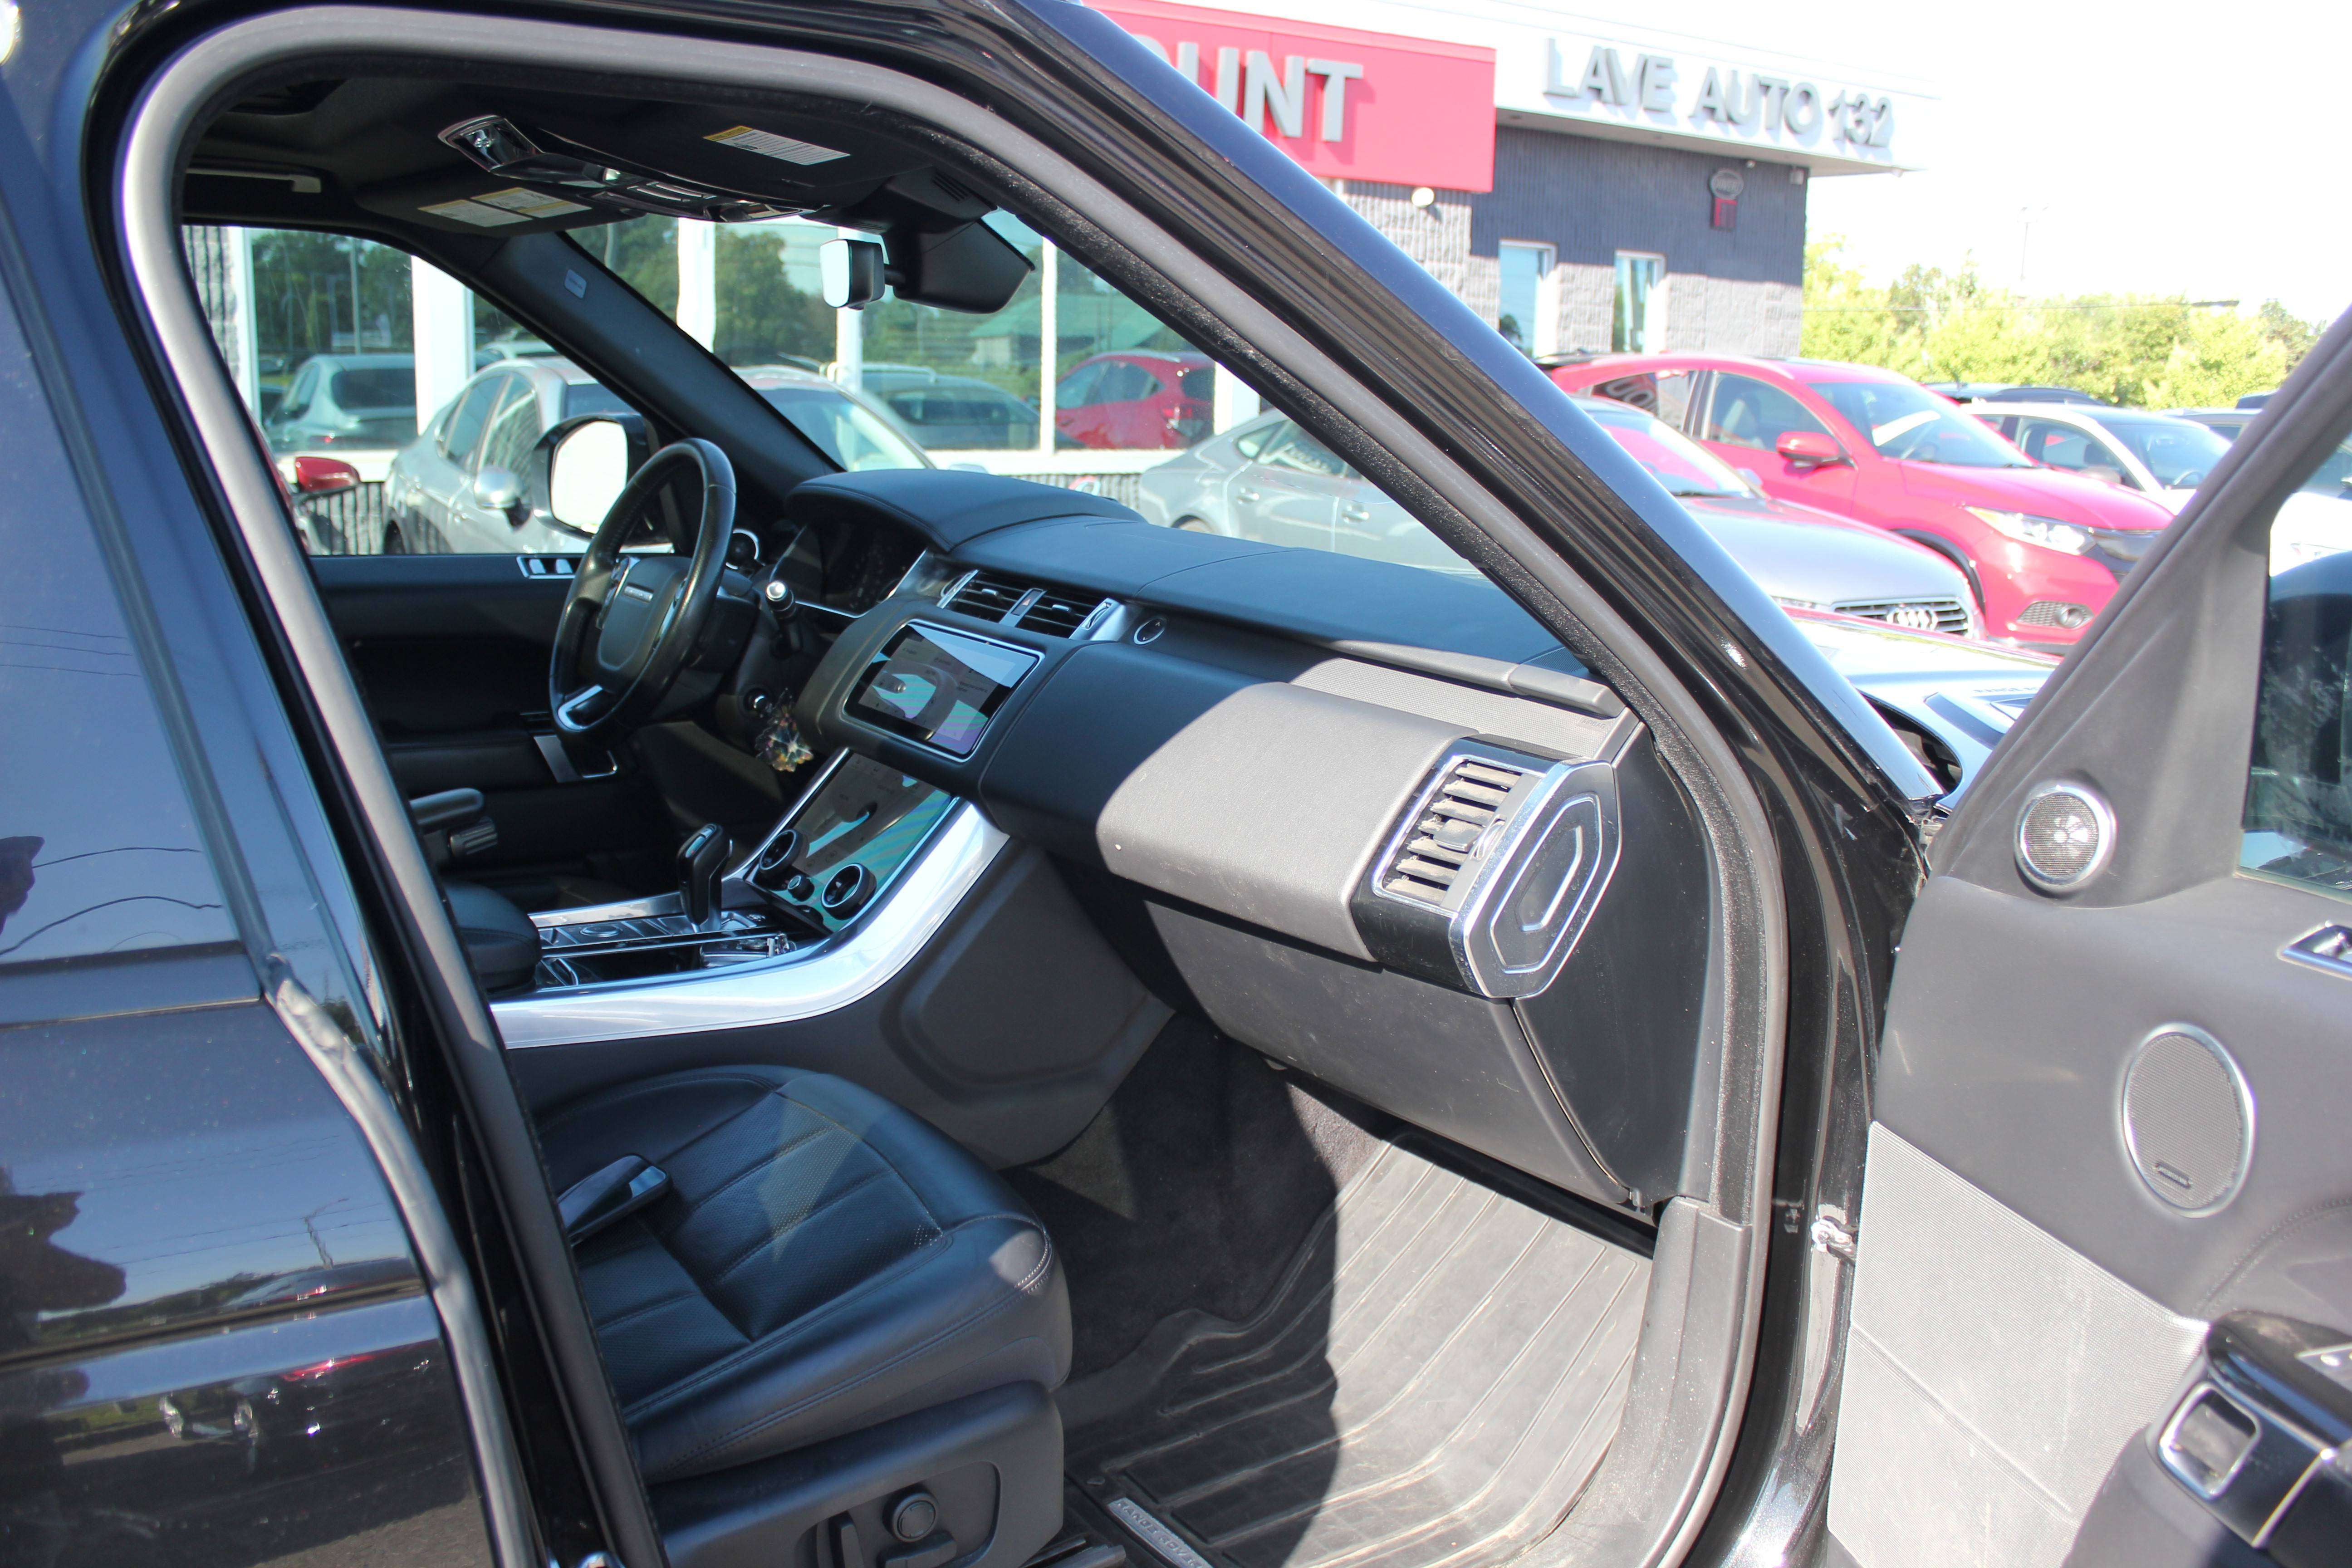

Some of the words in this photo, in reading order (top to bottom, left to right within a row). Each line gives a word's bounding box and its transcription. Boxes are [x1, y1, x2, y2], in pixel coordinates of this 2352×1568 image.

[1543, 38, 1674, 113] LAVE
[1688, 66, 1821, 135] AUTO
[1828, 89, 1893, 147] 132
[1581, 719, 1606, 729] AIRBAG
